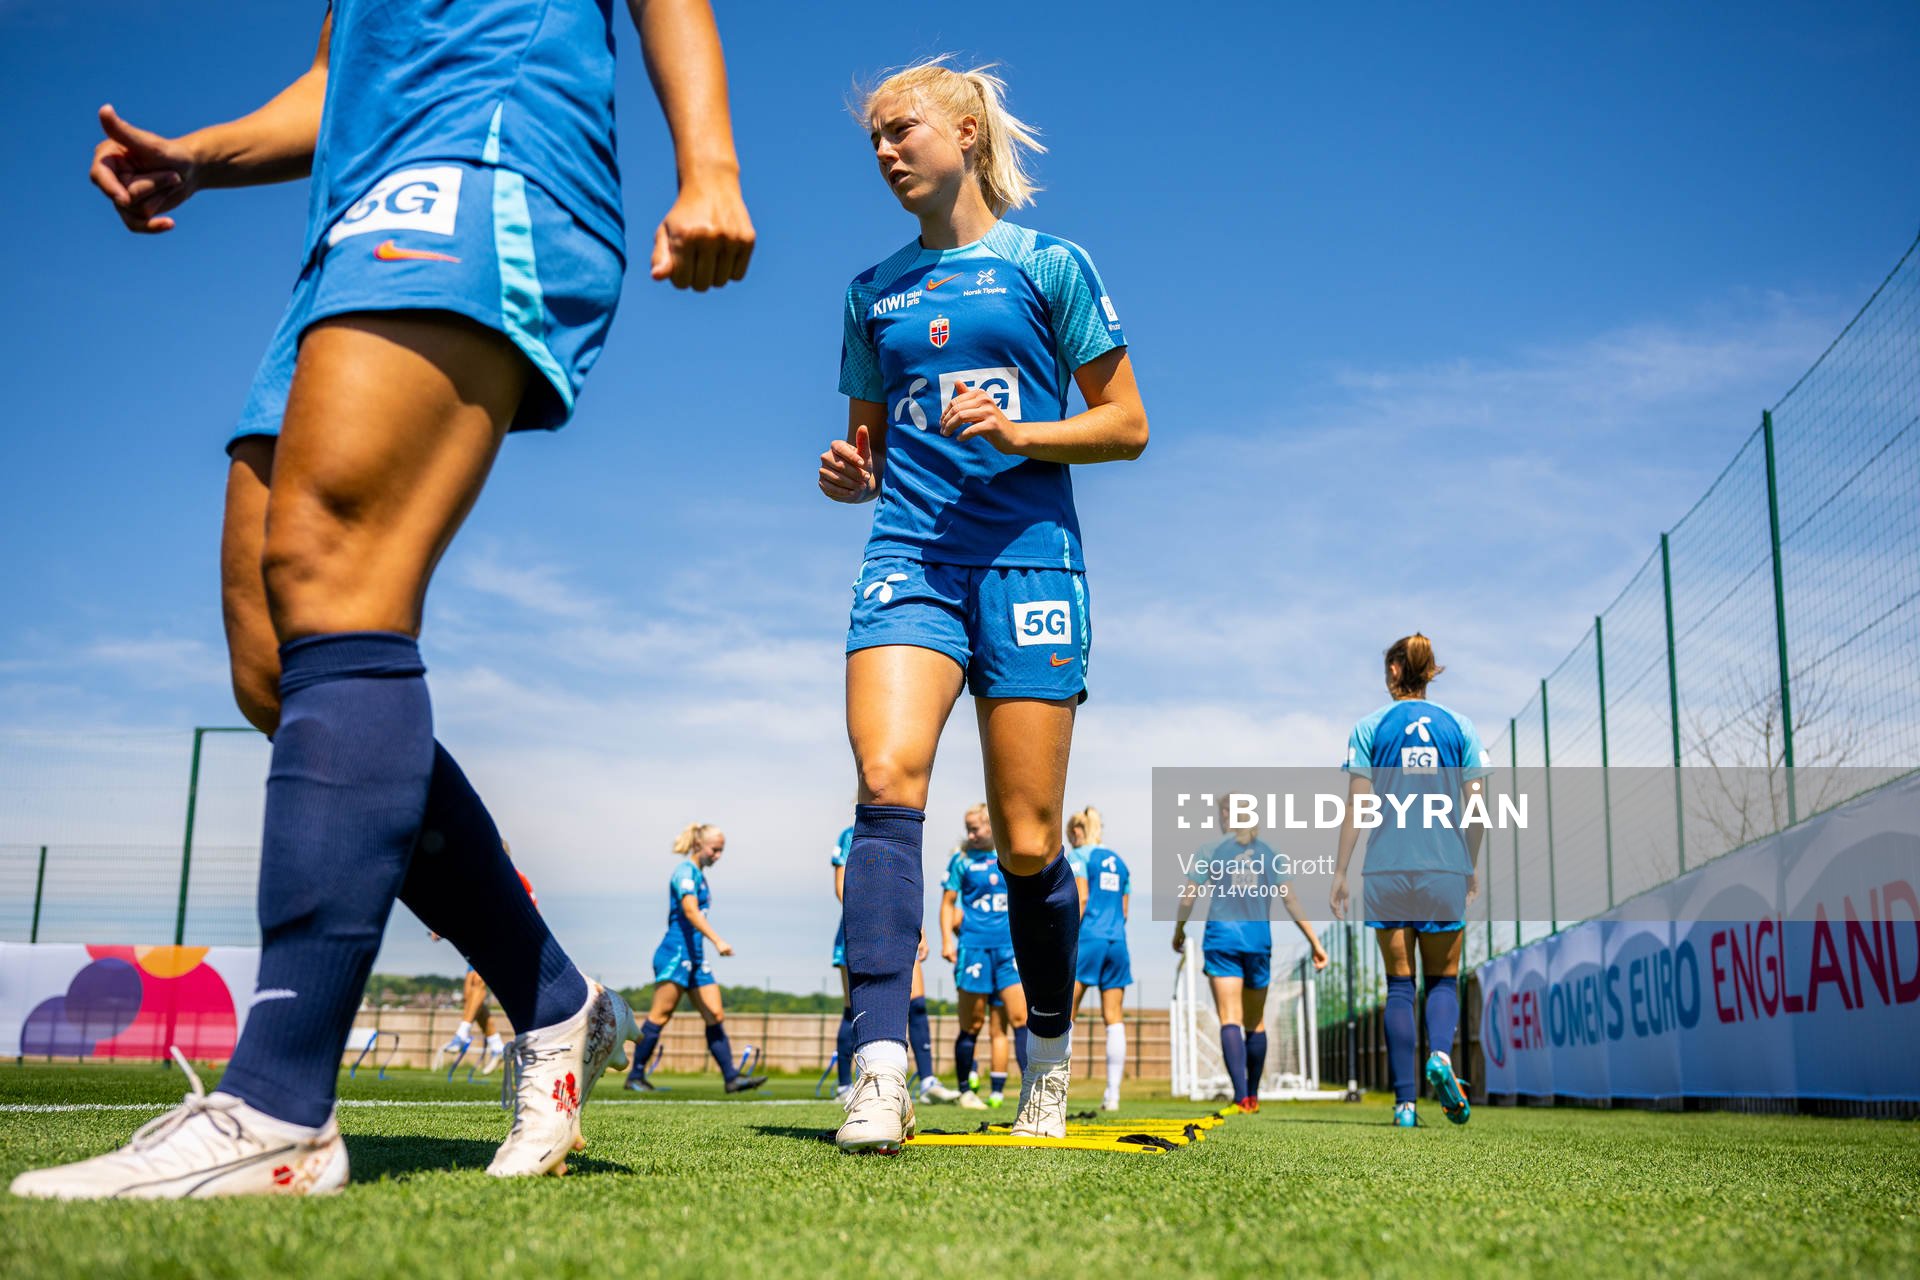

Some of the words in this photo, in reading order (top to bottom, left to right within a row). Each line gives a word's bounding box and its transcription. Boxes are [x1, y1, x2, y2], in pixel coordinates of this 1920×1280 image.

[343, 181, 440, 225] 5G
[906, 289, 923, 300] mini
[963, 288, 982, 297] Norsk
[982, 286, 1008, 295] Tipping
[873, 293, 905, 318] KIWI
[906, 297, 920, 308] pris
[1022, 608, 1066, 637] 5G
[1407, 752, 1432, 769] 5G
[1507, 989, 1543, 1050] EFA
[1629, 940, 1700, 1038] EURO
[1710, 879, 1920, 1025] ENGLAND
